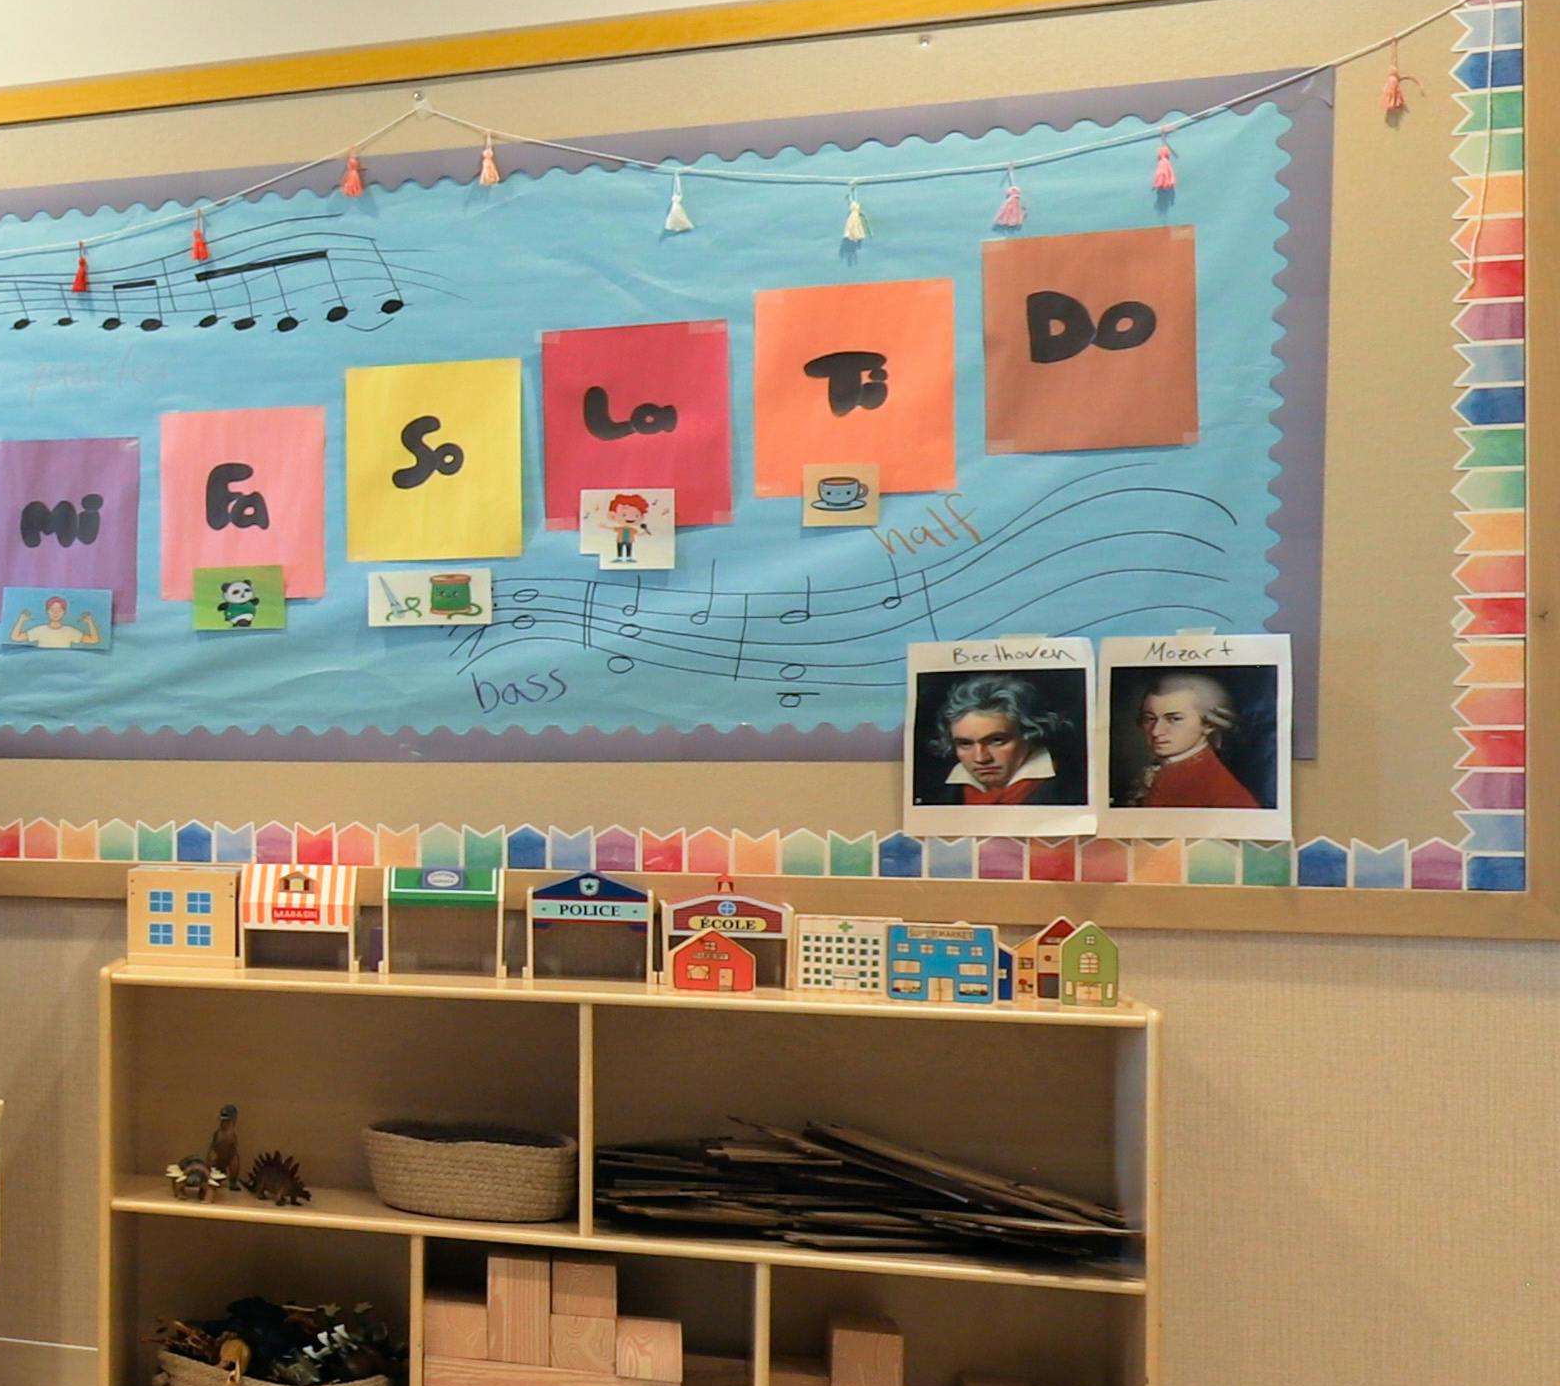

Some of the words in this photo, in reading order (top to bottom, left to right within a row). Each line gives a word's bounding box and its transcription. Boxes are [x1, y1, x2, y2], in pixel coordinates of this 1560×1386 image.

[1026, 290, 1157, 364] Do
[803, 351, 888, 417] Ti
[582, 385, 678, 441] La
[391, 415, 465, 489] So
[20, 493, 104, 549] Mi
[205, 462, 270, 530] Fa
[873, 493, 982, 555] half
[952, 642, 1077, 666] Beethoven
[1143, 641, 1235, 662] Mozart
[472, 669, 568, 714] bass
[559, 903, 621, 918] POLICE
[699, 916, 757, 931] ÉCOLE
